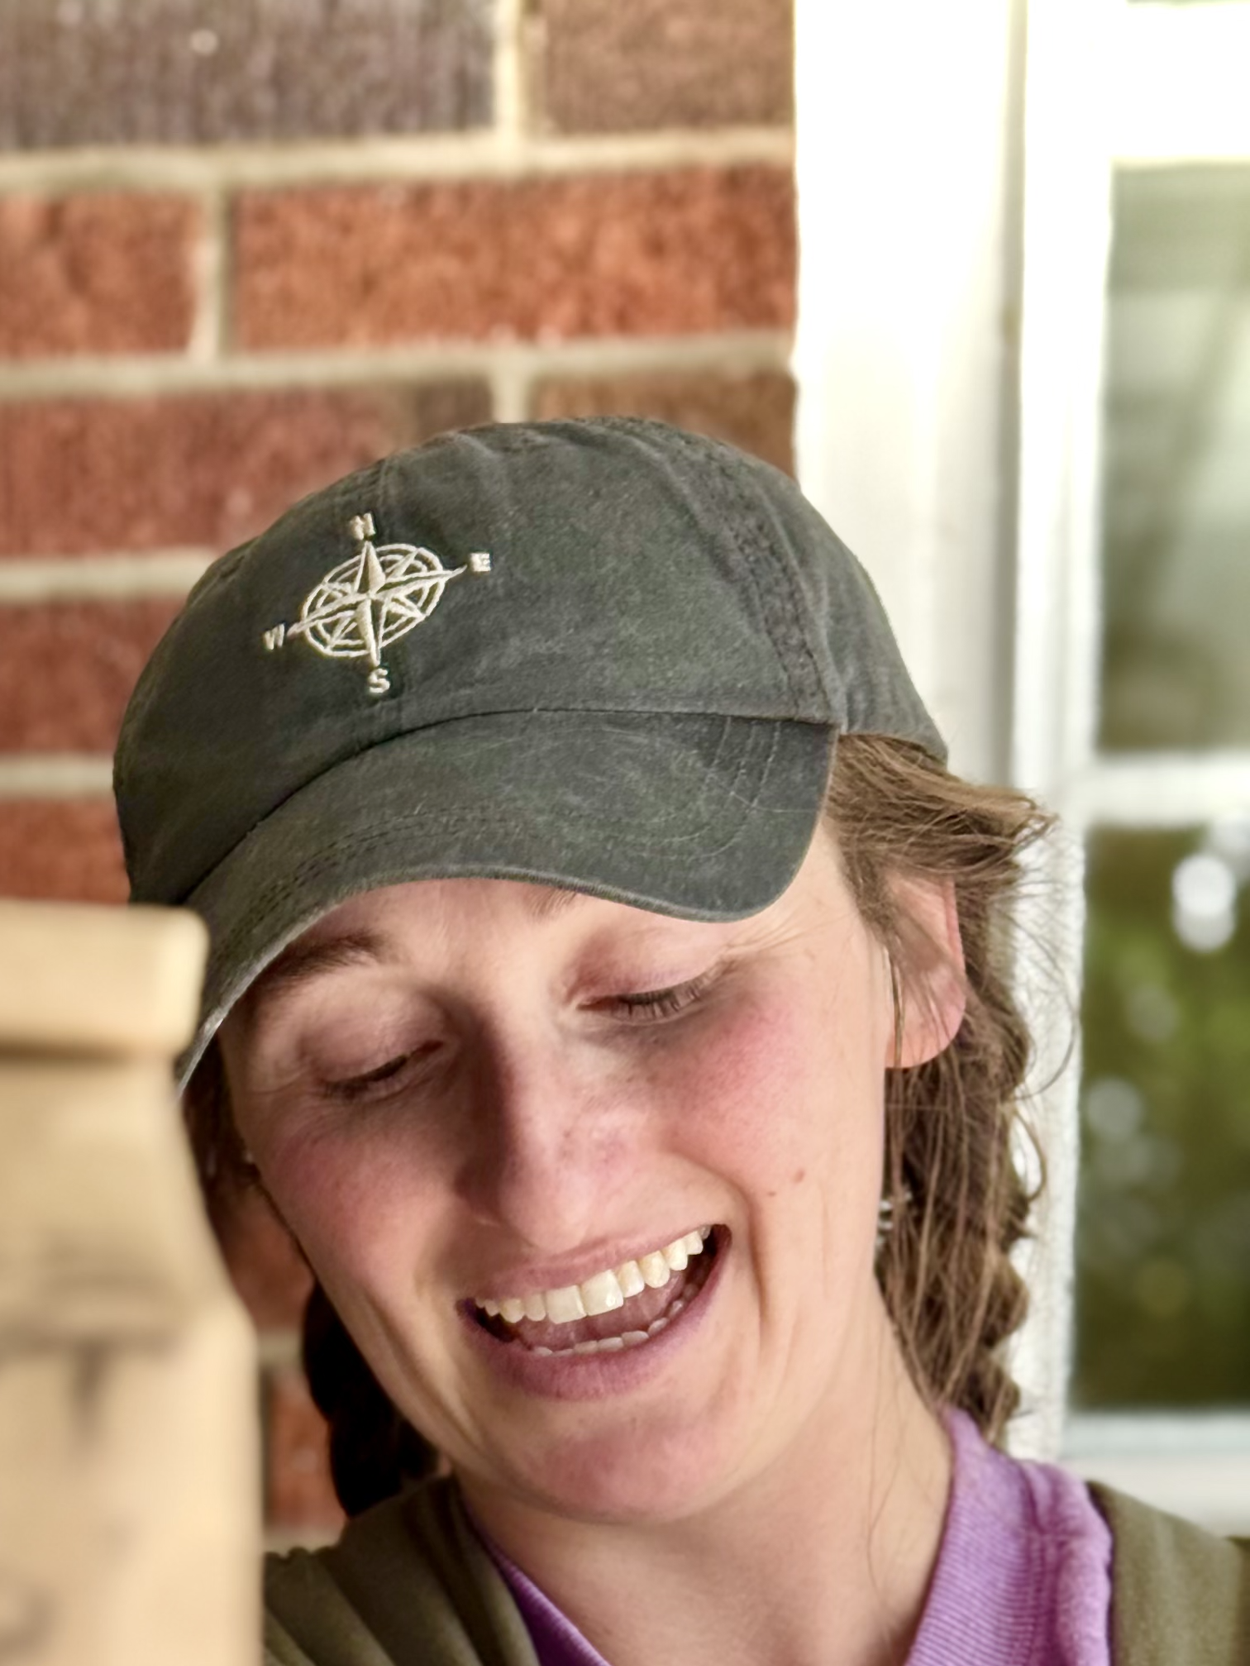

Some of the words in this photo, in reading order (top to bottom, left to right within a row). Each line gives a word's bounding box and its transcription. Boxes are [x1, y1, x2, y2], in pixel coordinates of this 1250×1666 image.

[350, 512, 376, 540] N
[469, 552, 492, 572] E
[263, 623, 285, 651] W
[367, 667, 390, 694] S
